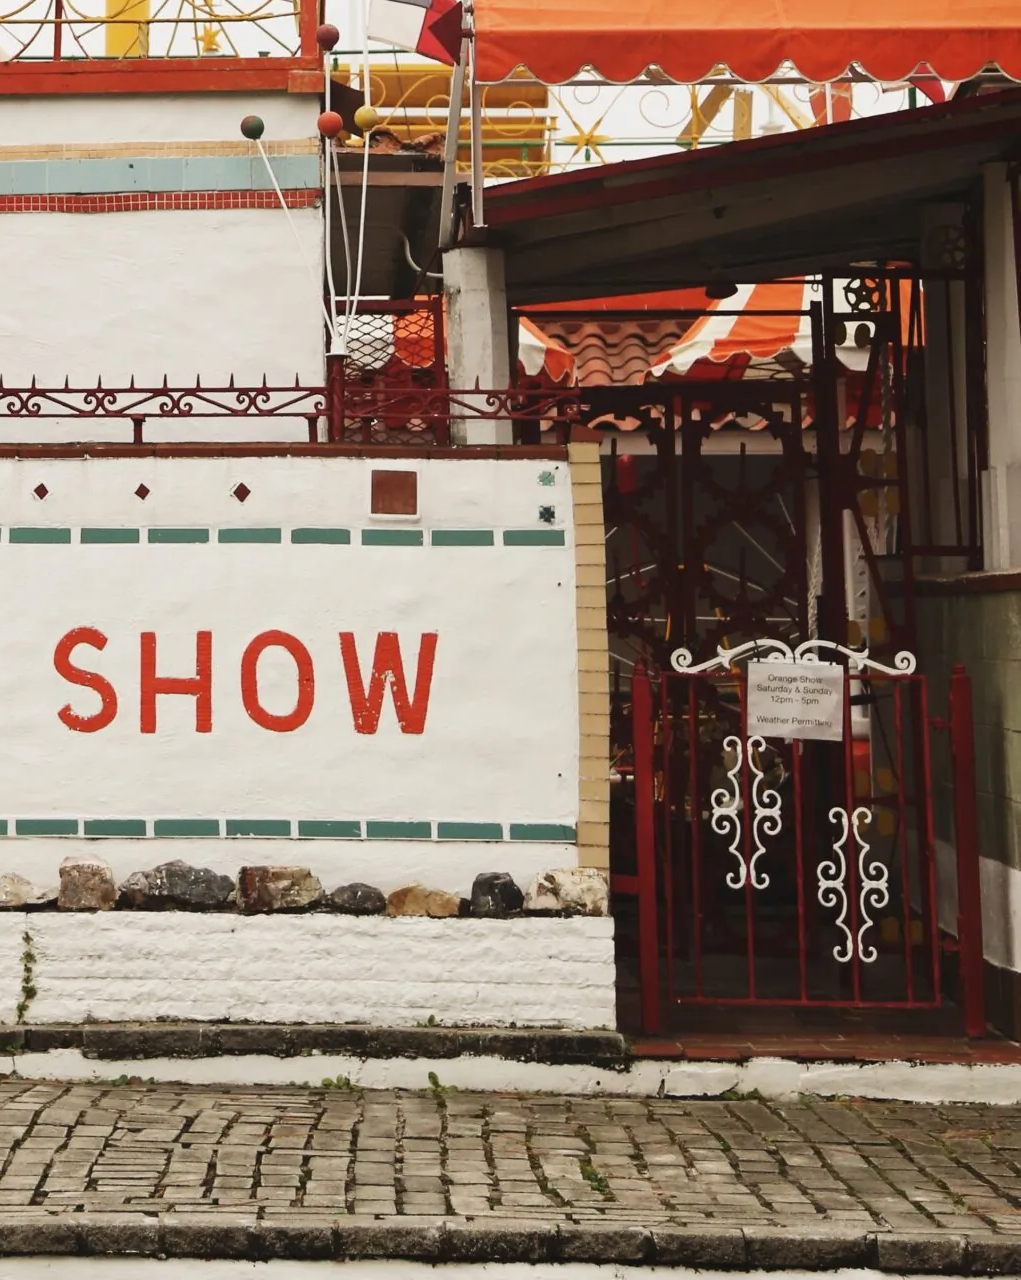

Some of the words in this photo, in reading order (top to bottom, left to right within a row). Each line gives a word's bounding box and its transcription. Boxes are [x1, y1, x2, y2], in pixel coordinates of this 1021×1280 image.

[54, 627, 438, 734] SHOW
[768, 674, 797, 684] Orange
[800, 676, 823, 684] Show
[757, 684, 792, 694] Saturday
[803, 686, 833, 696] Sunday
[771, 696, 793, 704] 12pm
[801, 697, 819, 705] 5pm
[757, 716, 789, 724] Weather
